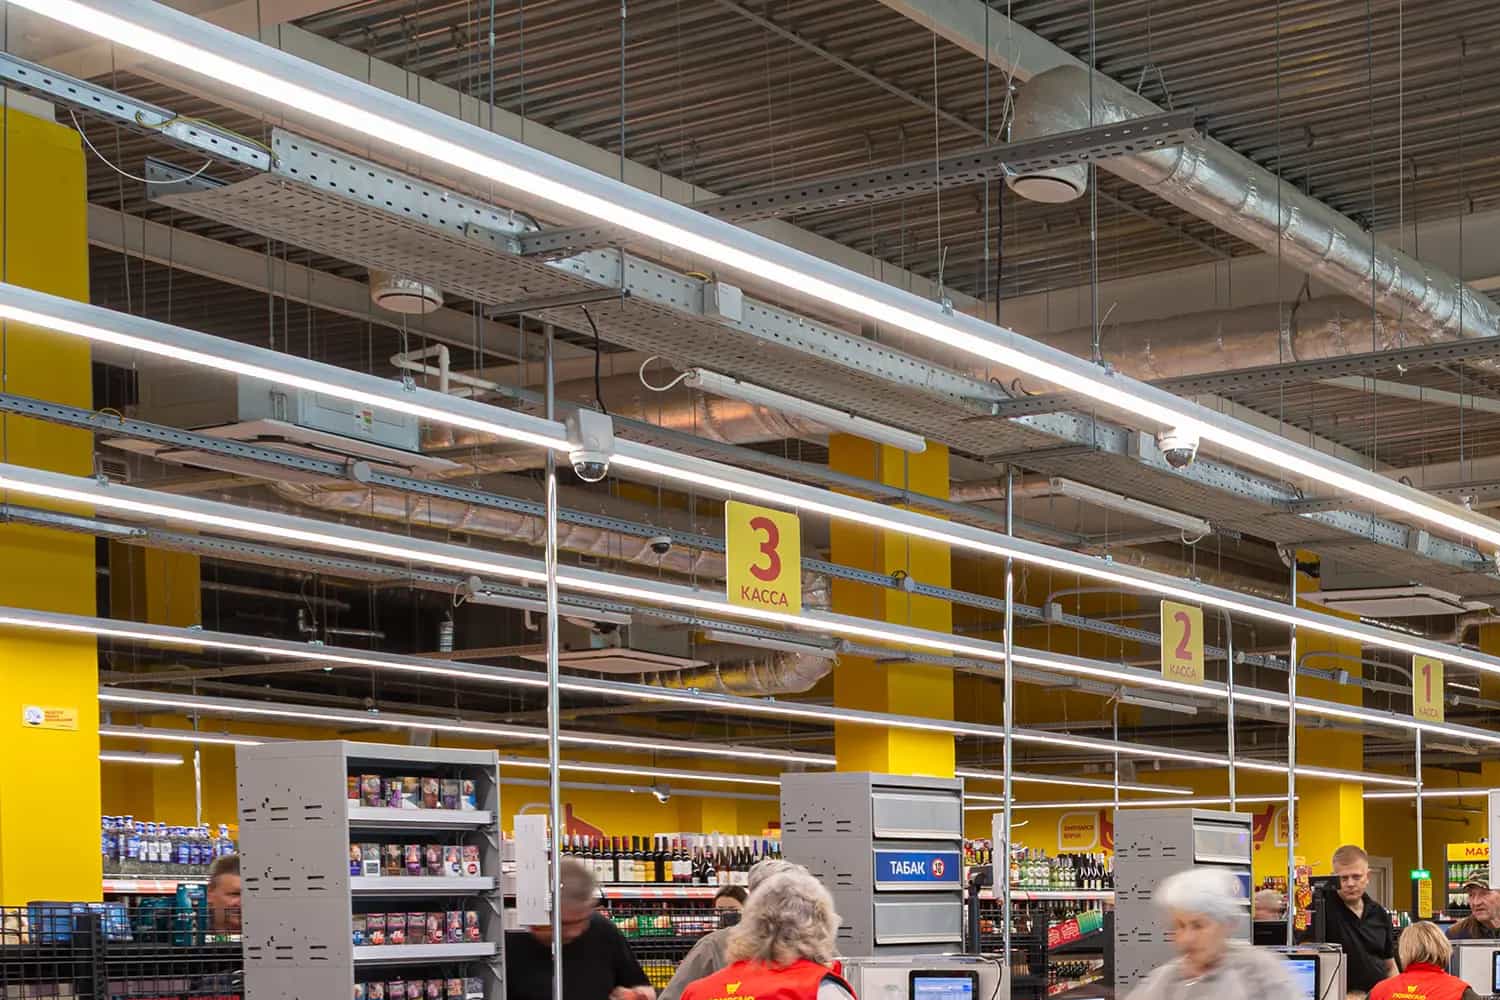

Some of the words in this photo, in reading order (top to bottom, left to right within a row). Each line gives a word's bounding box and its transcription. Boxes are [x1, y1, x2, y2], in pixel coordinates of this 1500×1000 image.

[749, 516, 782, 582] 3
[741, 585, 789, 608] КАССА
[1174, 610, 1193, 660] 2
[1422, 663, 1432, 704] 1
[889, 861, 926, 875] ТАБАК
